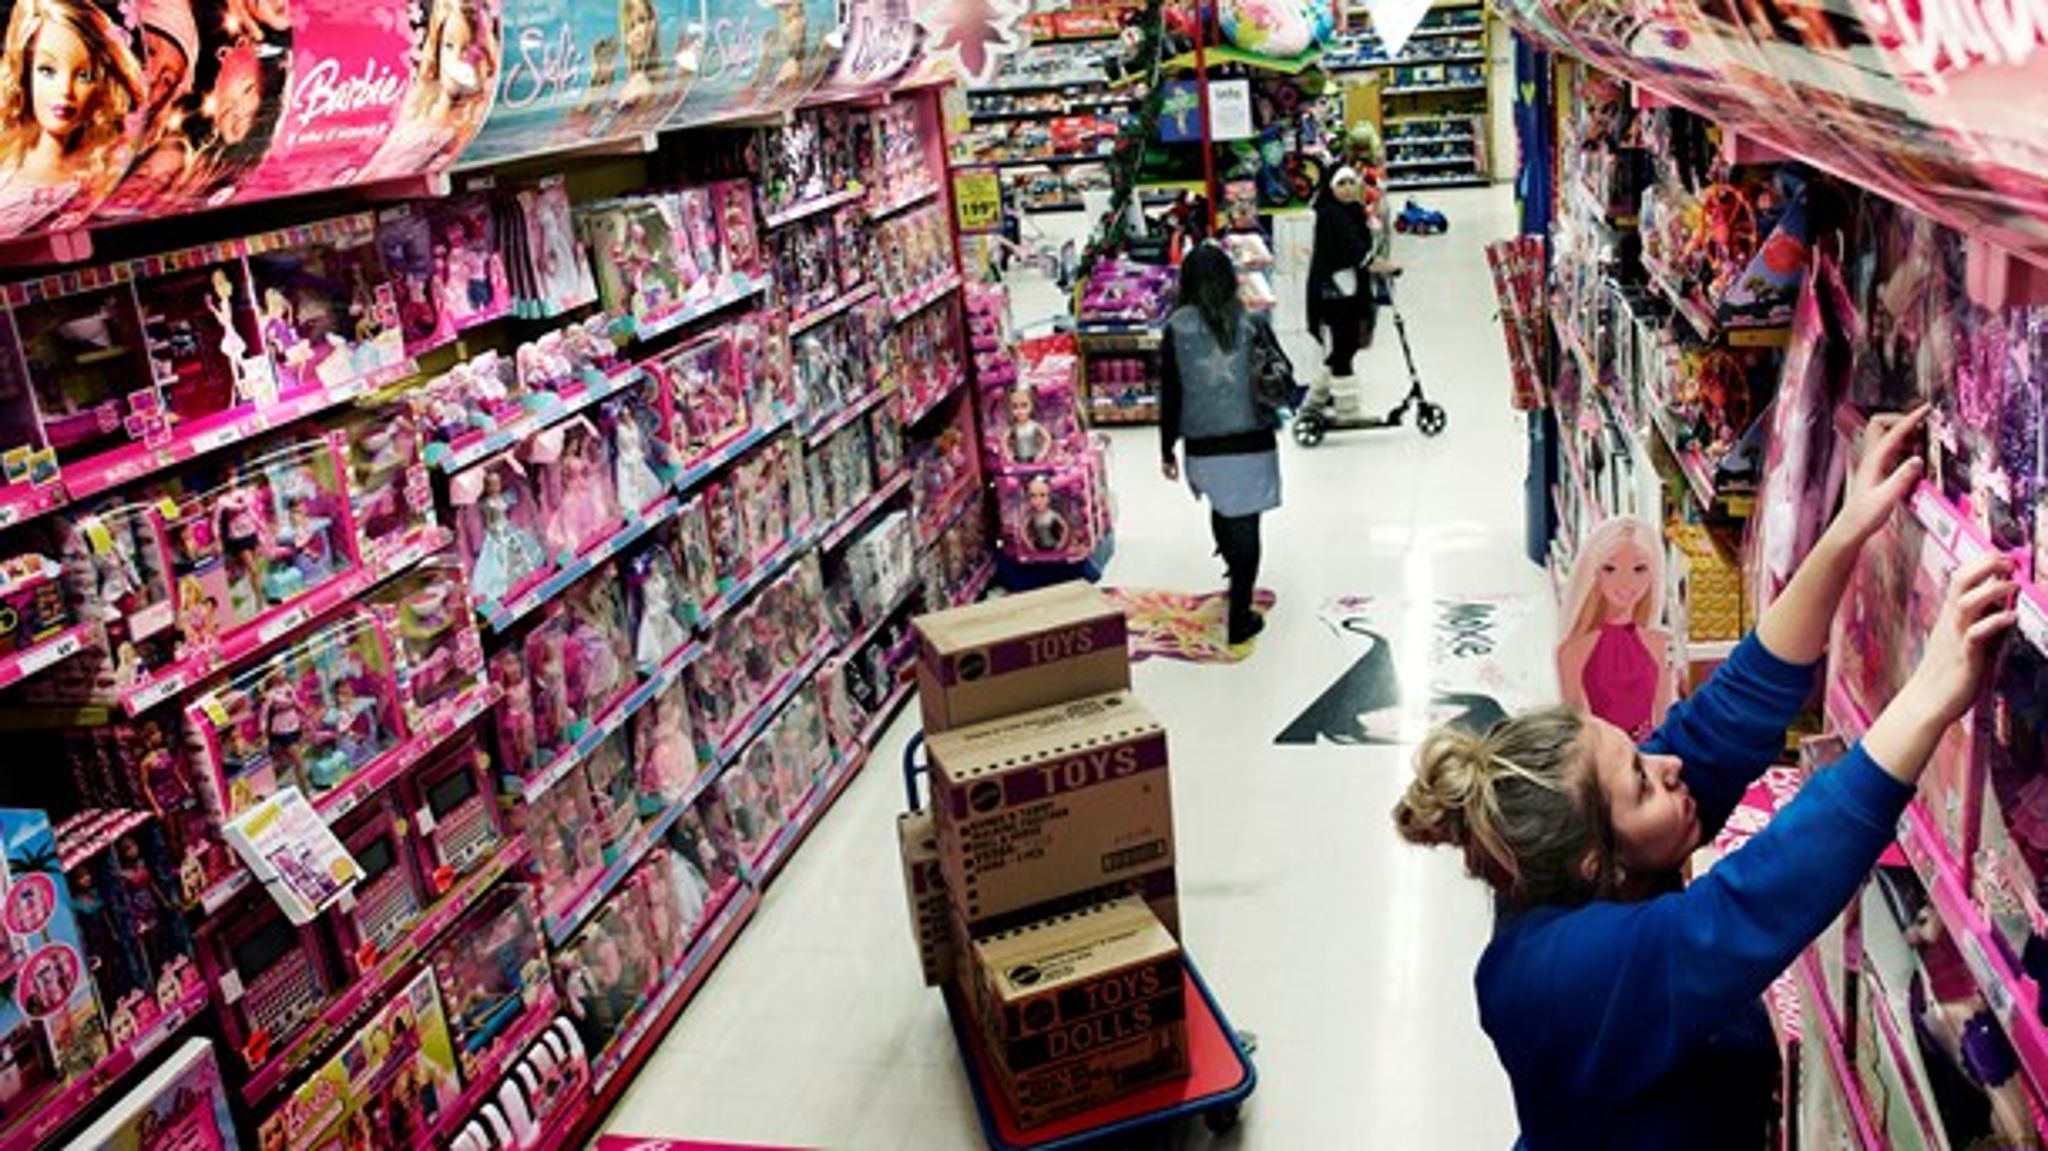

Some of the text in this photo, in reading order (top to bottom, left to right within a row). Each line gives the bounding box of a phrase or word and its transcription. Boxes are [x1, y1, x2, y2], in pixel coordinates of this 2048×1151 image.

[294, 58, 408, 127] Barbie
[1026, 627, 1094, 663] TOYS
[1039, 746, 1138, 793] TOYS
[1085, 965, 1160, 1010] TOYS
[1048, 1003, 1152, 1058] DOLLS
